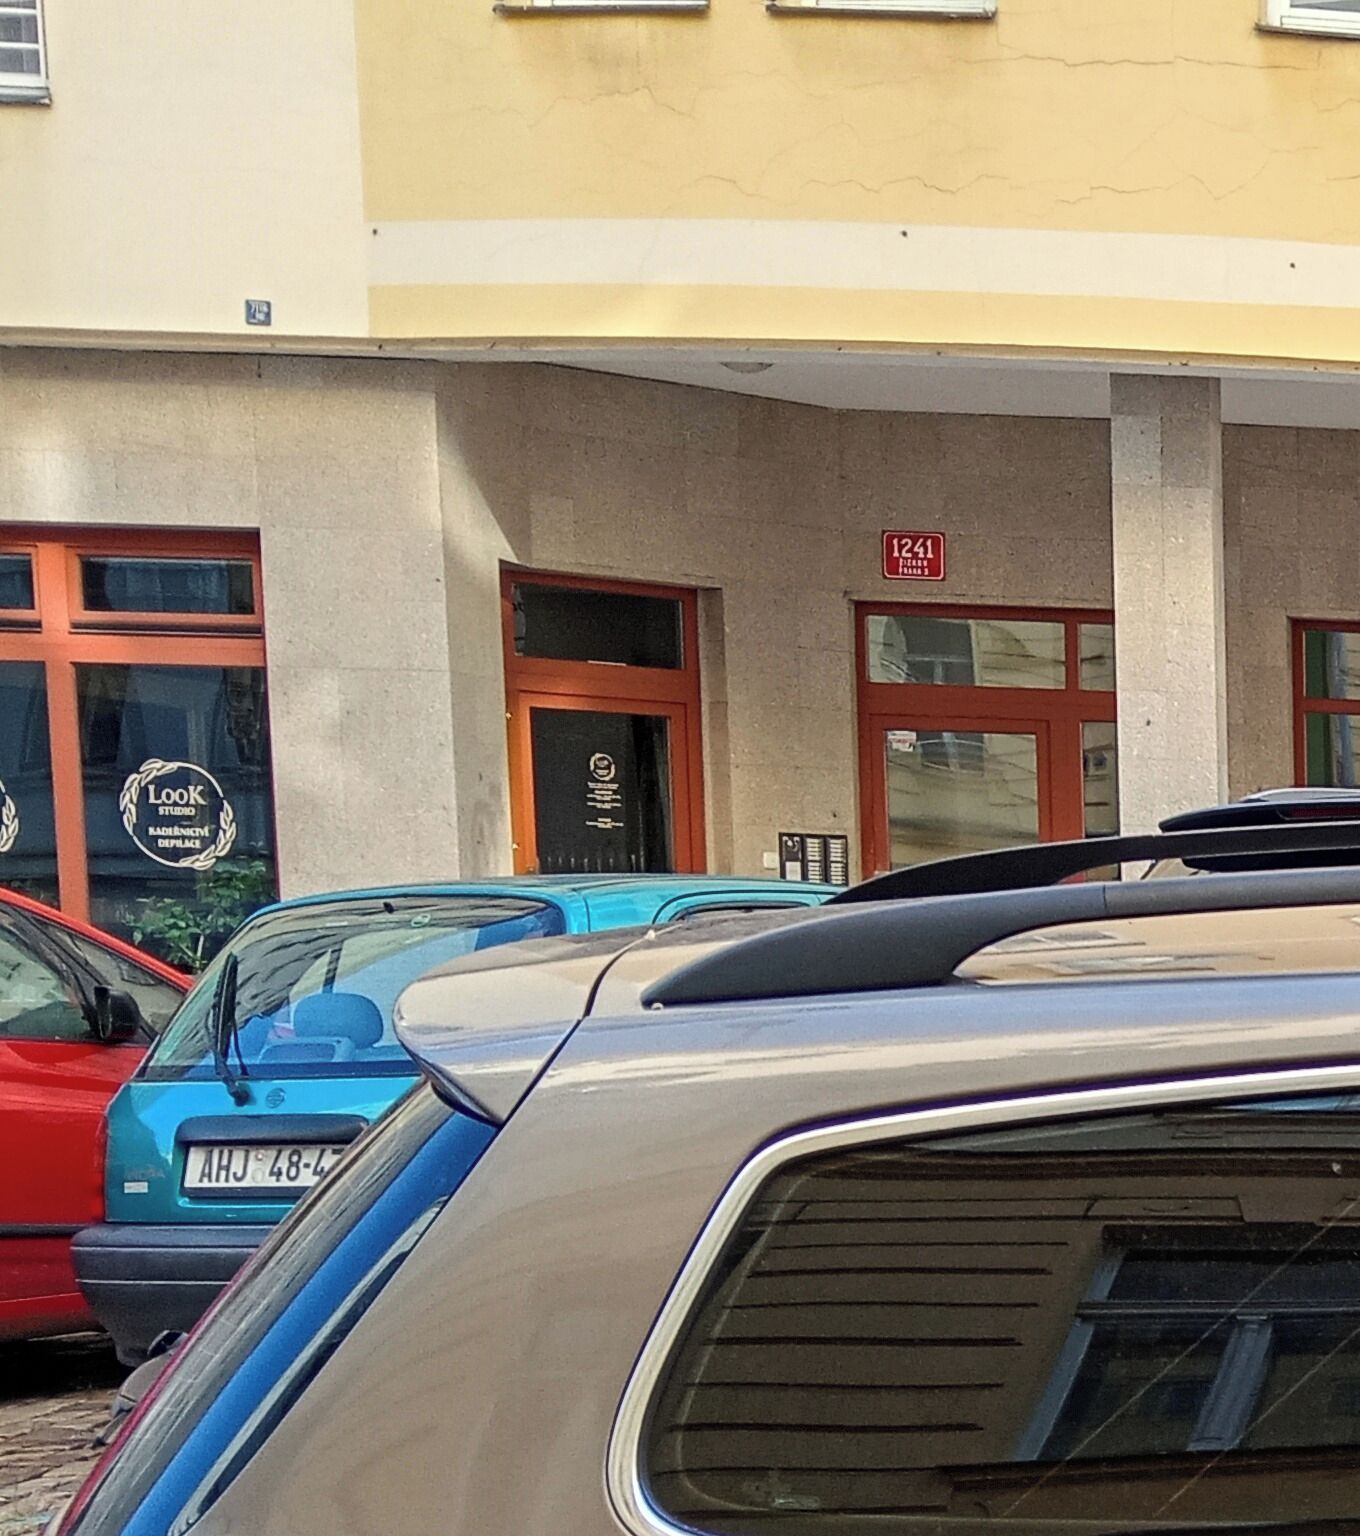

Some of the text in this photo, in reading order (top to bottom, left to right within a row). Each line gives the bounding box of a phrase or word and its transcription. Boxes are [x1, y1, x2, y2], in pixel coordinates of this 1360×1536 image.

[893, 537, 934, 558] 1241
[158, 806, 196, 816] STUDIO
[199, 1148, 345, 1184] AHJ 48-4
